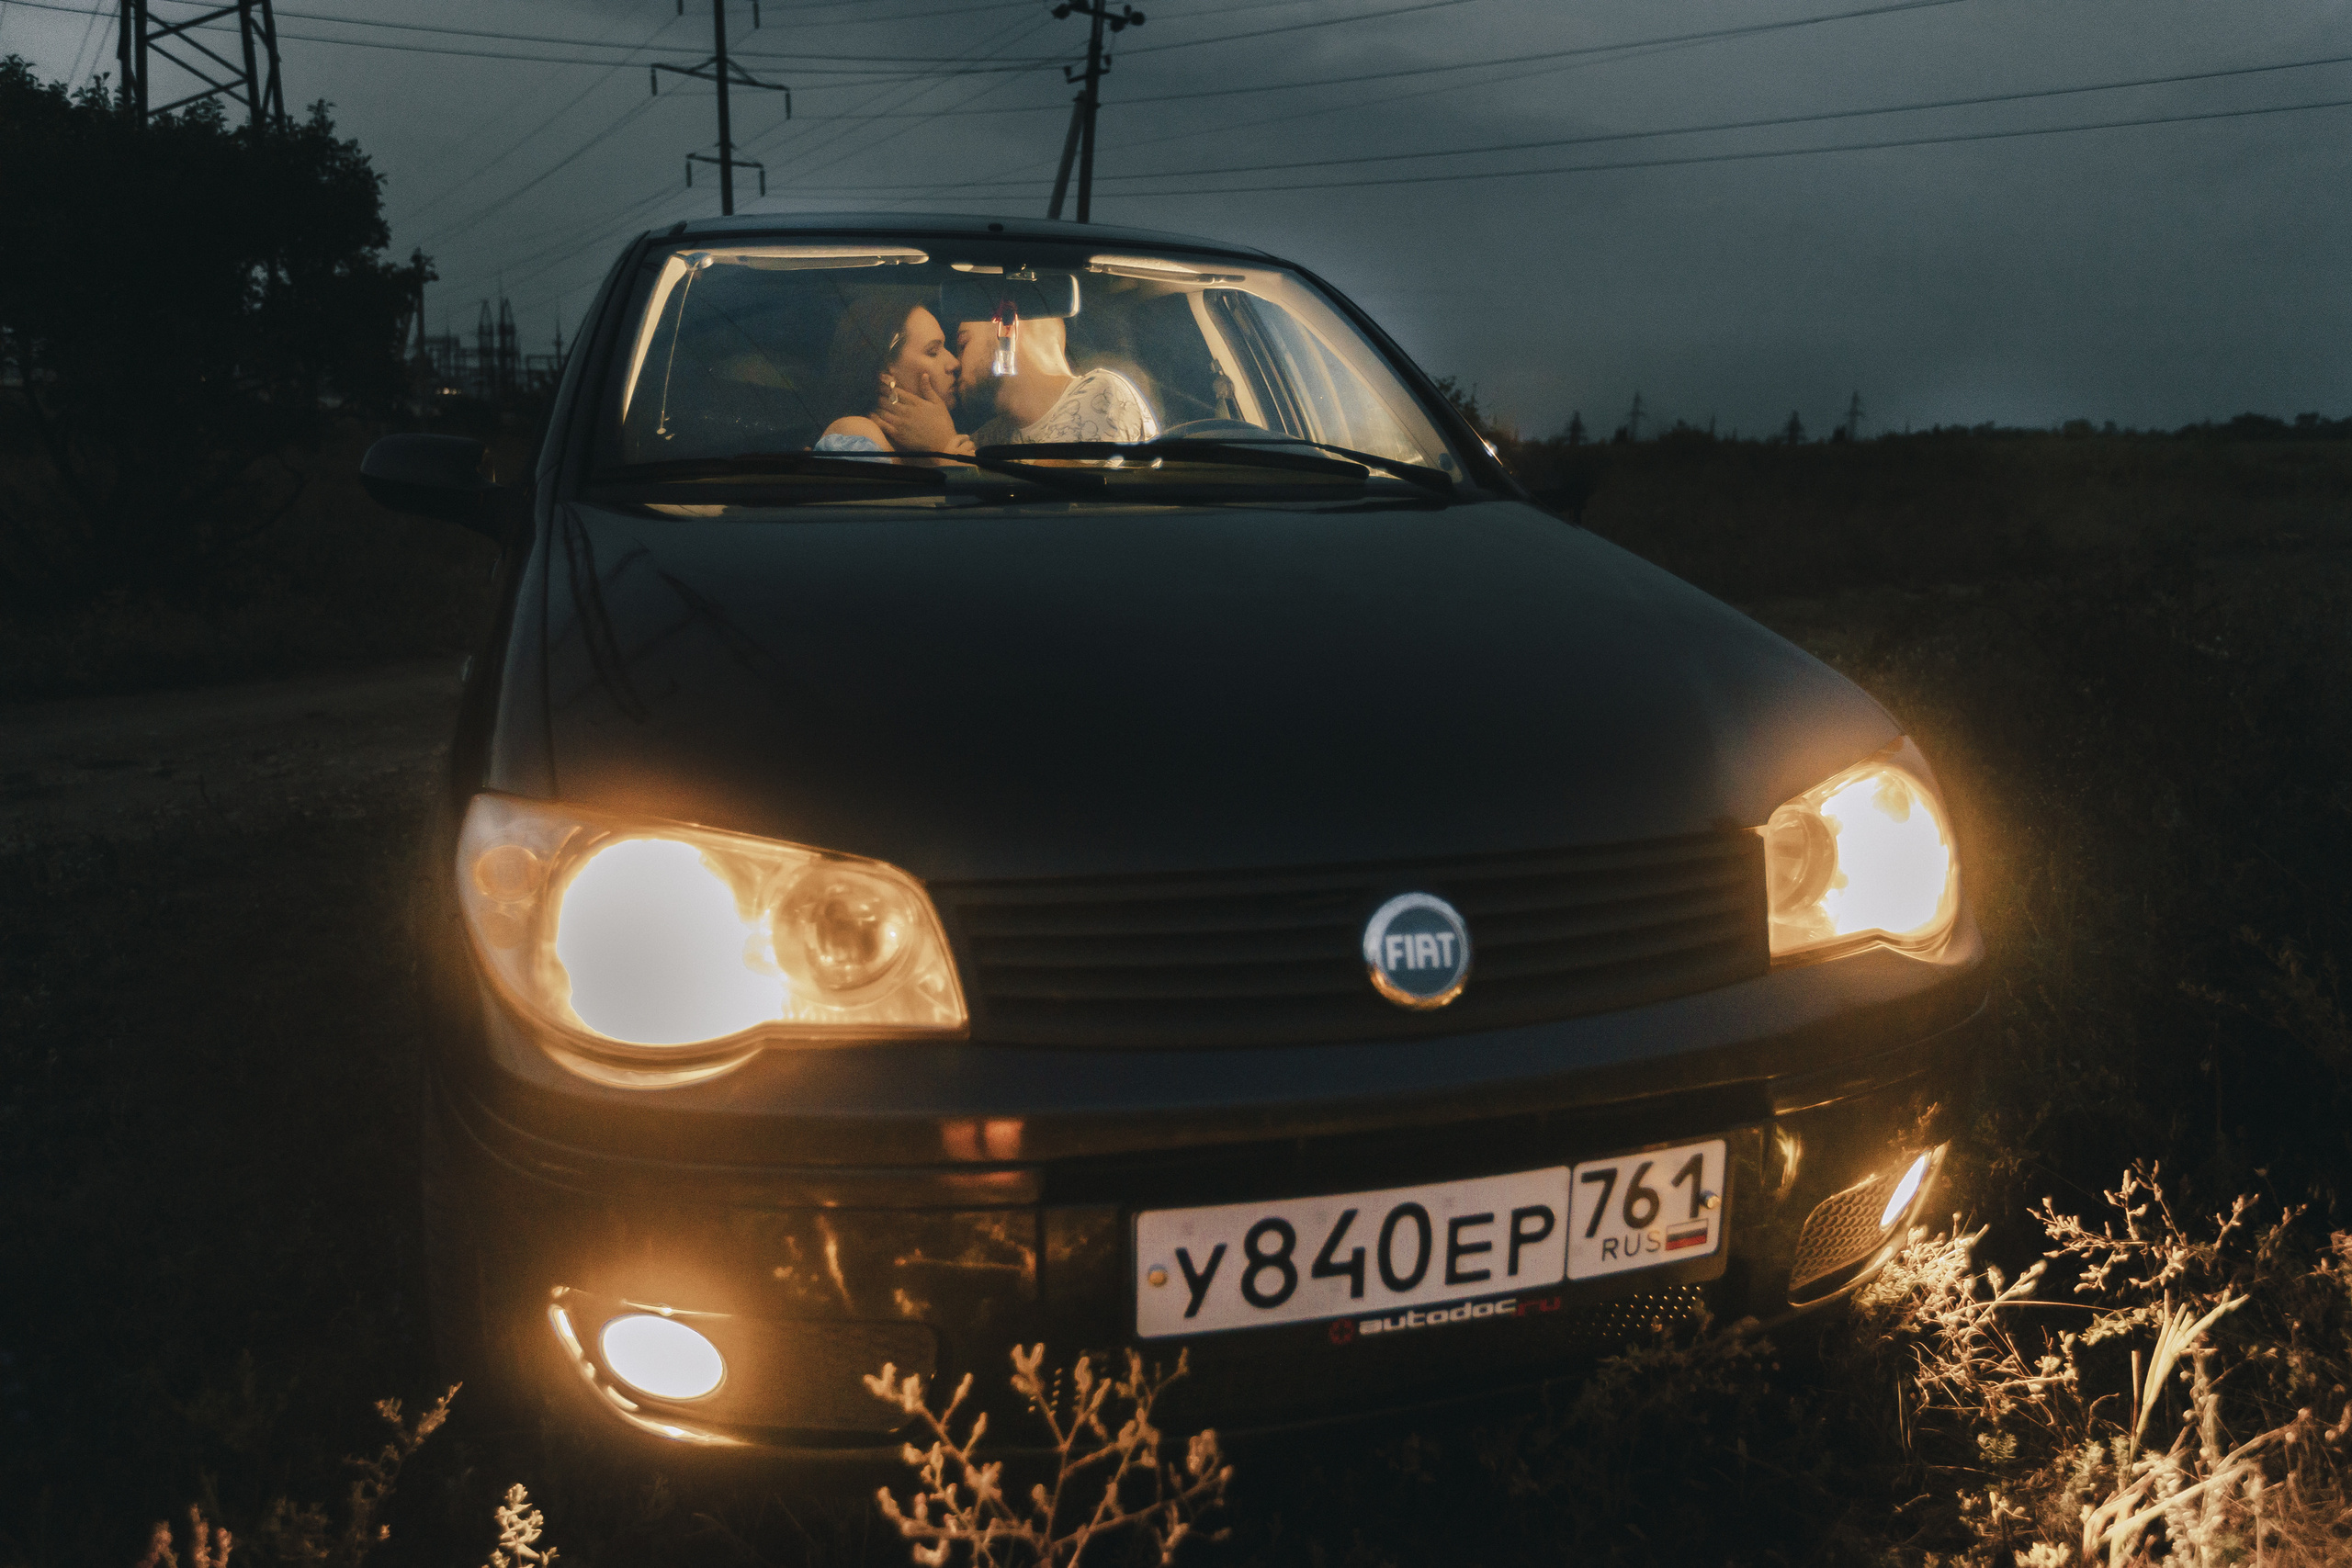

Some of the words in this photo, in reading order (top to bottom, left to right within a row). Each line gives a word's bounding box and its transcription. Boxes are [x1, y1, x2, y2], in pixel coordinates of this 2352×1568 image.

[1385, 931, 1455, 971] FIAT
[1581, 1153, 1704, 1238] 761
[1601, 1231, 1661, 1261] RUS
